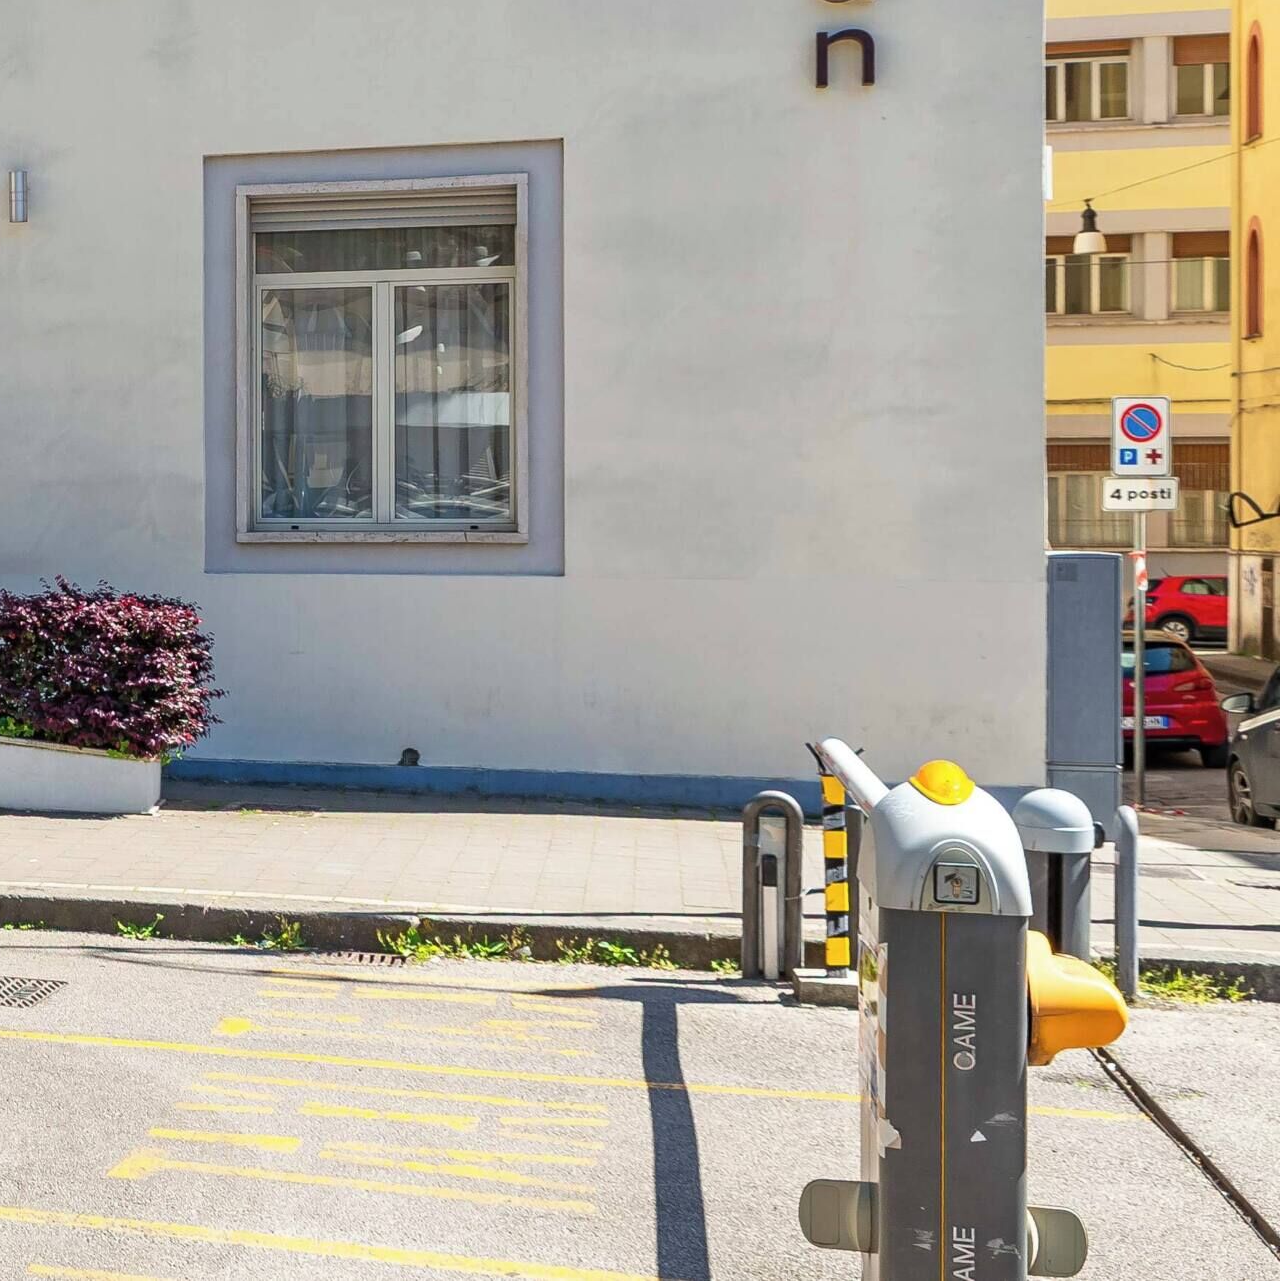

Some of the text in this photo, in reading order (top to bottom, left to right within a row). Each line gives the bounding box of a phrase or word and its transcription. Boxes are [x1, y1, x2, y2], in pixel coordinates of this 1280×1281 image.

[1110, 488, 1171, 501] 4 posti
[952, 1226, 976, 1281] AME
